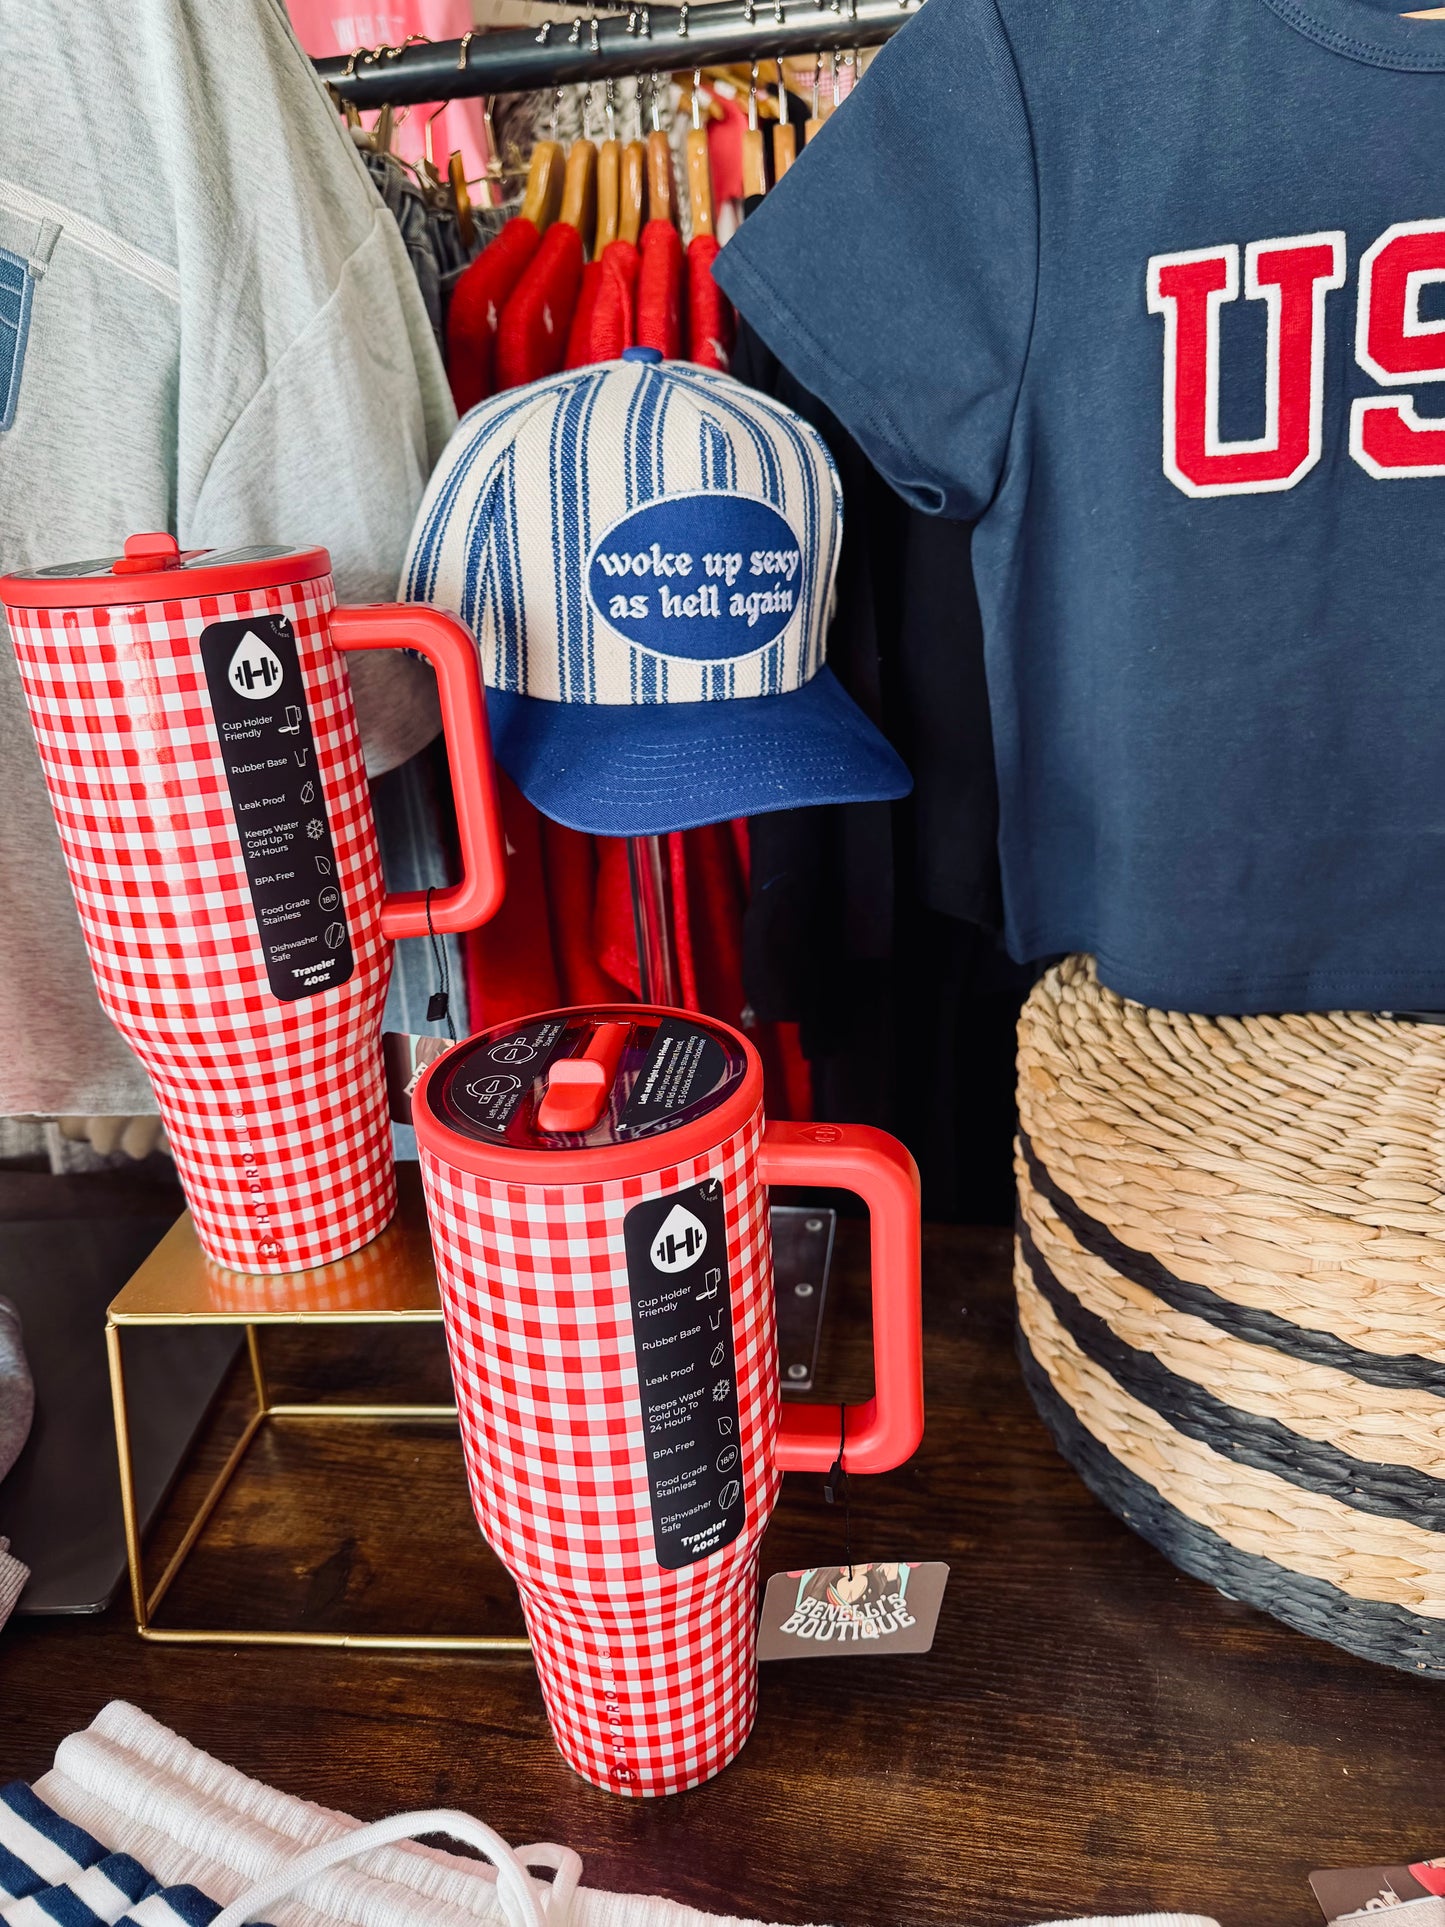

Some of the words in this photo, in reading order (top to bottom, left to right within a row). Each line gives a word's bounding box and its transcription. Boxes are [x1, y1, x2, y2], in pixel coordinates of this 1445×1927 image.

[596, 542, 694, 578] woke
[701, 552, 743, 587] up
[749, 550, 800, 582] sexy
[608, 594, 650, 619] as
[658, 583, 722, 619] hell
[729, 581, 794, 628] again
[222, 720, 242, 733] Cup
[244, 715, 273, 728] Holder
[224, 729, 262, 742] Friendly
[231, 761, 265, 774] Rubber
[267, 757, 288, 768] Base
[239, 800, 262, 811] Leak
[262, 794, 286, 806] Proof
[245, 826, 273, 839] Keeps
[273, 821, 300, 833] Water
[247, 837, 268, 849] Cold
[269, 835, 283, 845] Up
[284, 832, 294, 841] To
[248, 850, 260, 859] 24
[262, 844, 289, 856] Hours
[255, 875, 275, 886] BPA
[276, 871, 295, 881] Free
[261, 904, 284, 916] Food
[285, 898, 311, 910] Grade
[262, 911, 302, 926] Stainless
[269, 935, 319, 954] Dishwasher
[271, 953, 291, 963] Safe
[291, 958, 336, 978] Traveler
[303, 972, 331, 986] 40oz
[658, 1037, 674, 1056] Friendly
[653, 1056, 665, 1069] Hand
[647, 1069, 660, 1083] Right
[644, 1083, 654, 1093] and
[637, 1093, 650, 1105] Left
[231, 1107, 270, 1225] HYDROJUG
[637, 1297, 659, 1309] Cup
[660, 1285, 692, 1303] Holder
[639, 1301, 678, 1319] Friendly
[642, 1334, 678, 1351] Rubber
[679, 1325, 701, 1340] Base
[645, 1373, 669, 1387] Leak
[670, 1362, 695, 1379] Proof
[648, 1398, 677, 1414] Keeps
[678, 1386, 705, 1404] Water
[649, 1410, 671, 1423] Cold
[673, 1405, 687, 1416] Up
[687, 1400, 699, 1410] To
[650, 1424, 662, 1434] 24
[664, 1413, 692, 1429] Hours
[653, 1447, 674, 1460] BPA
[675, 1439, 695, 1453] Free
[656, 1474, 680, 1489] Food
[681, 1464, 708, 1480] Grade
[656, 1479, 697, 1498] Stainless
[660, 1499, 712, 1525] Dishwasher
[661, 1521, 682, 1534] Safe
[680, 1518, 727, 1547] Traveler
[692, 1534, 720, 1554] 40oz
[794, 1592, 908, 1623] BENELLI'S
[779, 1607, 917, 1642] BOUTIQUE
